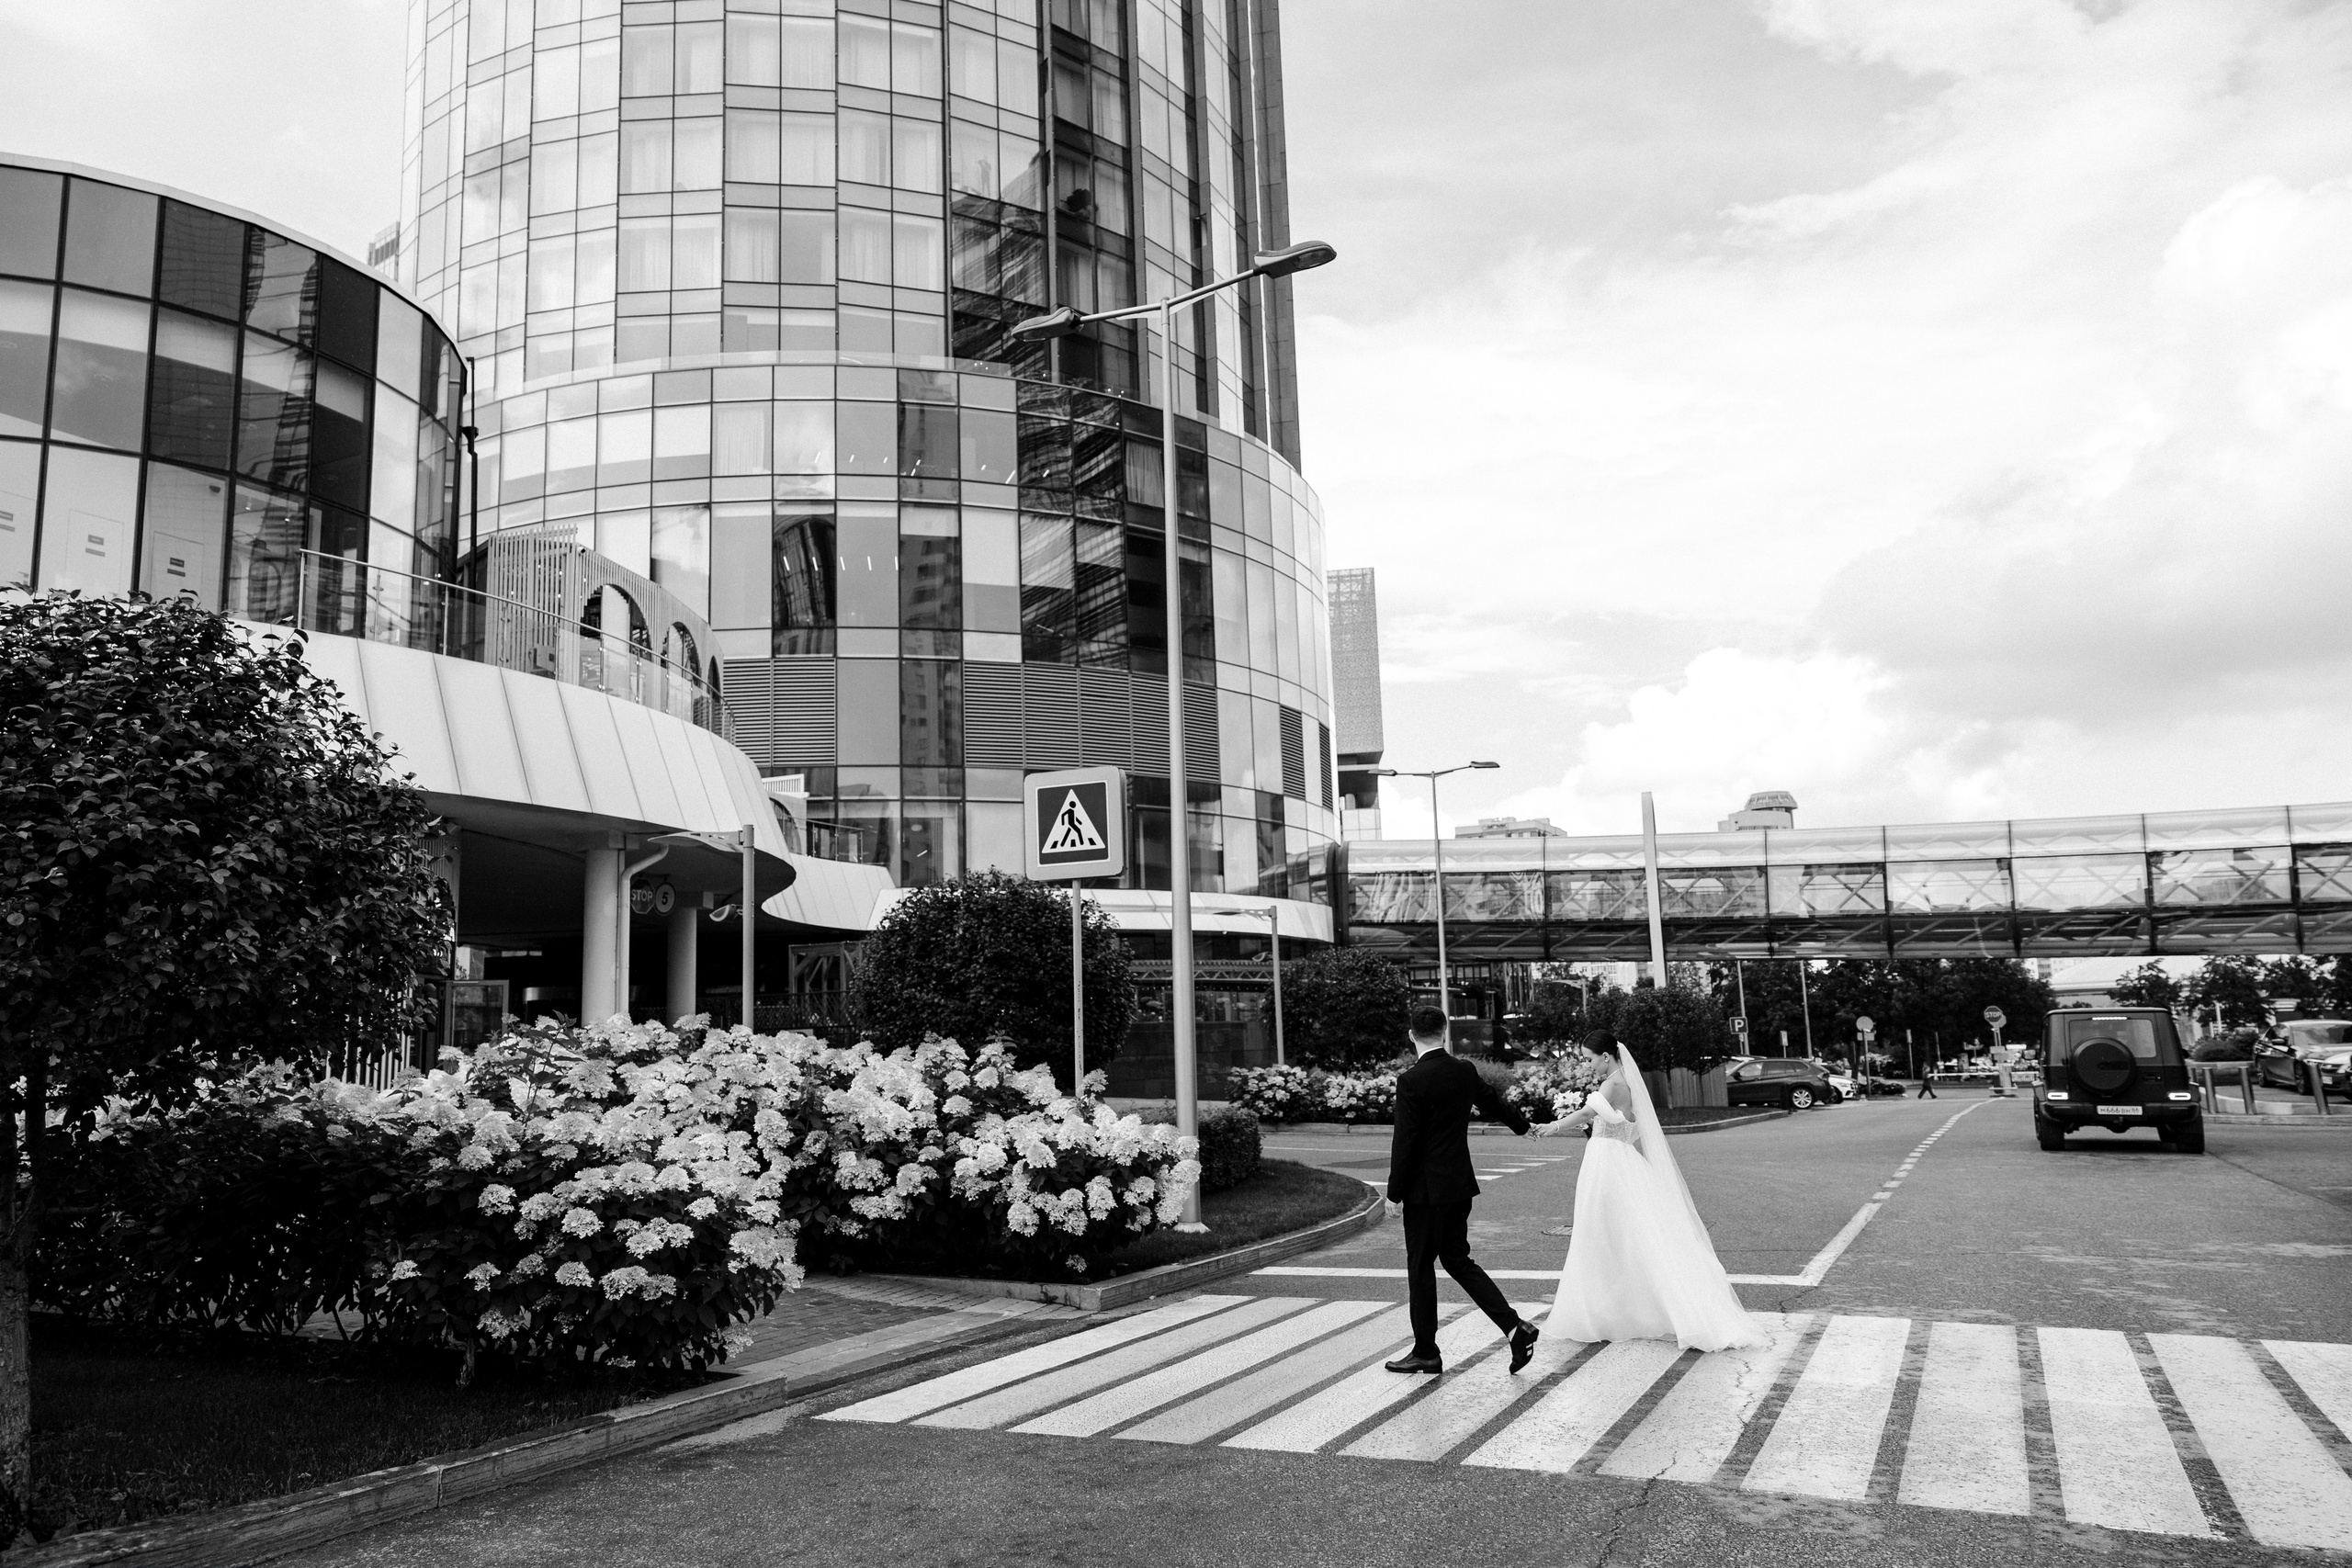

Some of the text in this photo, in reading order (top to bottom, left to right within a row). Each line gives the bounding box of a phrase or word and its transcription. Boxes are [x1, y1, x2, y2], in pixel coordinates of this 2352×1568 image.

[631, 888, 653, 902] STOP
[662, 891, 669, 905] 5
[1735, 1019, 1744, 1032] P
